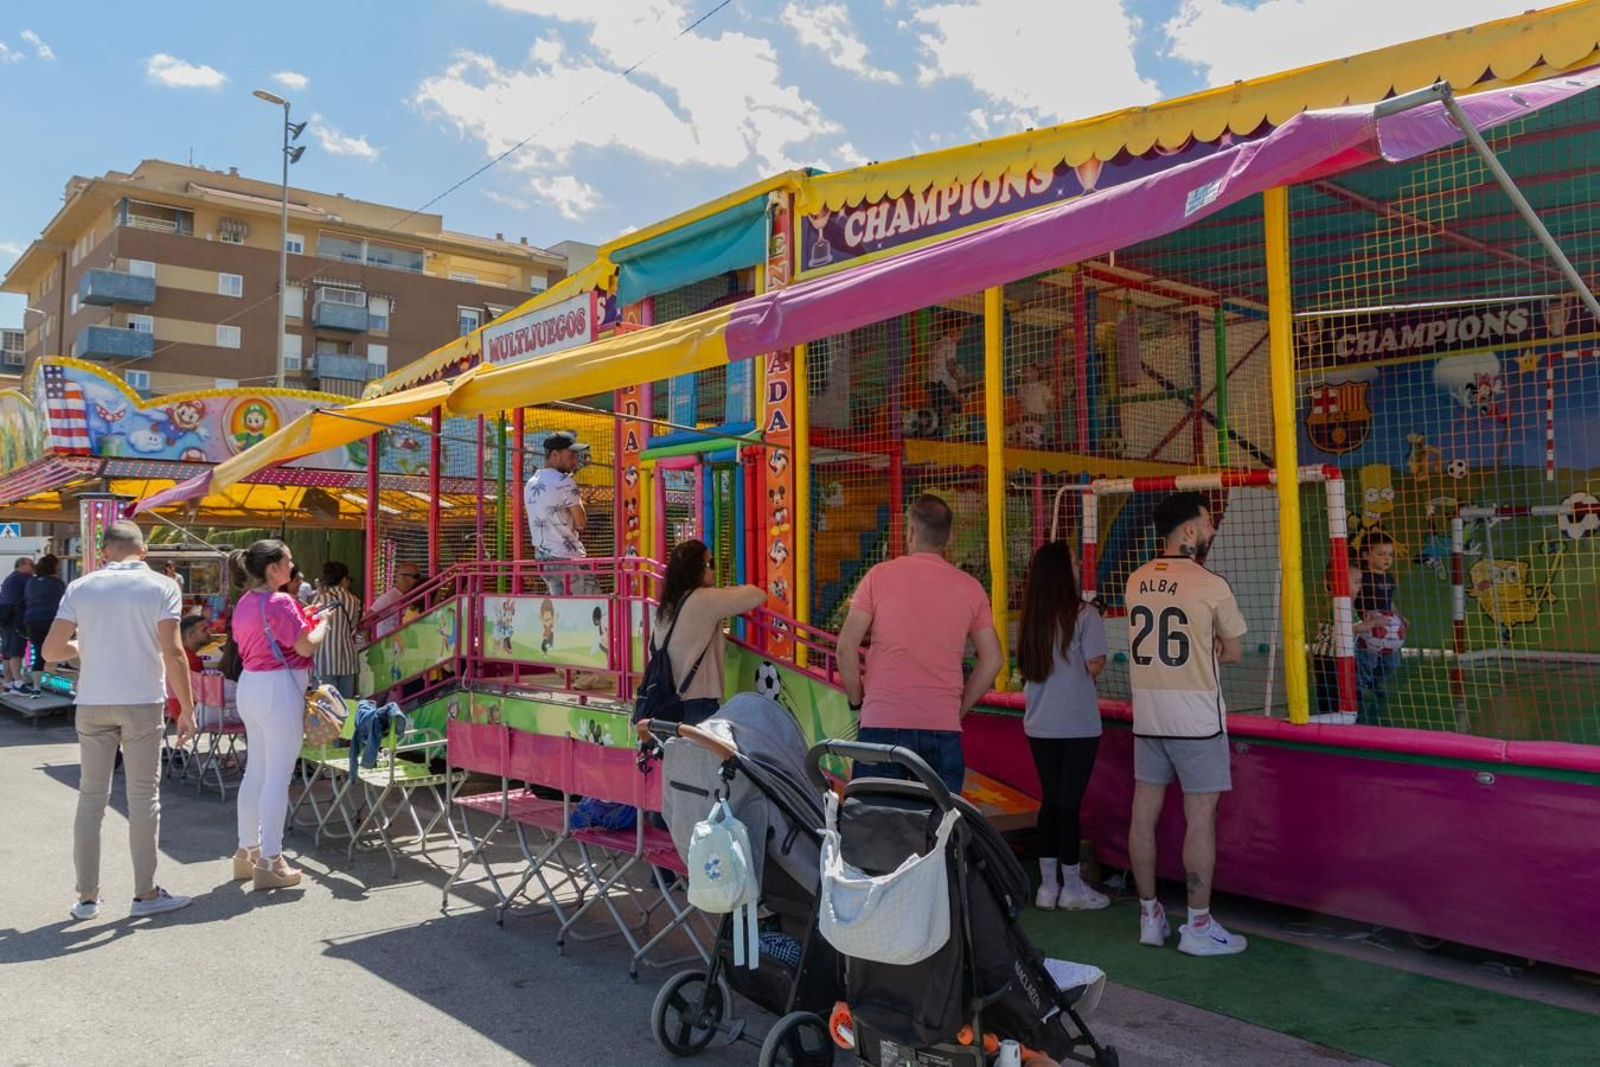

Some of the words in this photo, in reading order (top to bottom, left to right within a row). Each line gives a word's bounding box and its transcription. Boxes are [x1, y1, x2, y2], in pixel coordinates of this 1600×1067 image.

[844, 166, 1054, 247] CHAMPIONS
[489, 307, 586, 362] MULTIJUEGOS
[1336, 308, 1529, 358] CHAMPIONS
[1140, 579, 1178, 595] ALBA
[1130, 604, 1190, 668] 26
